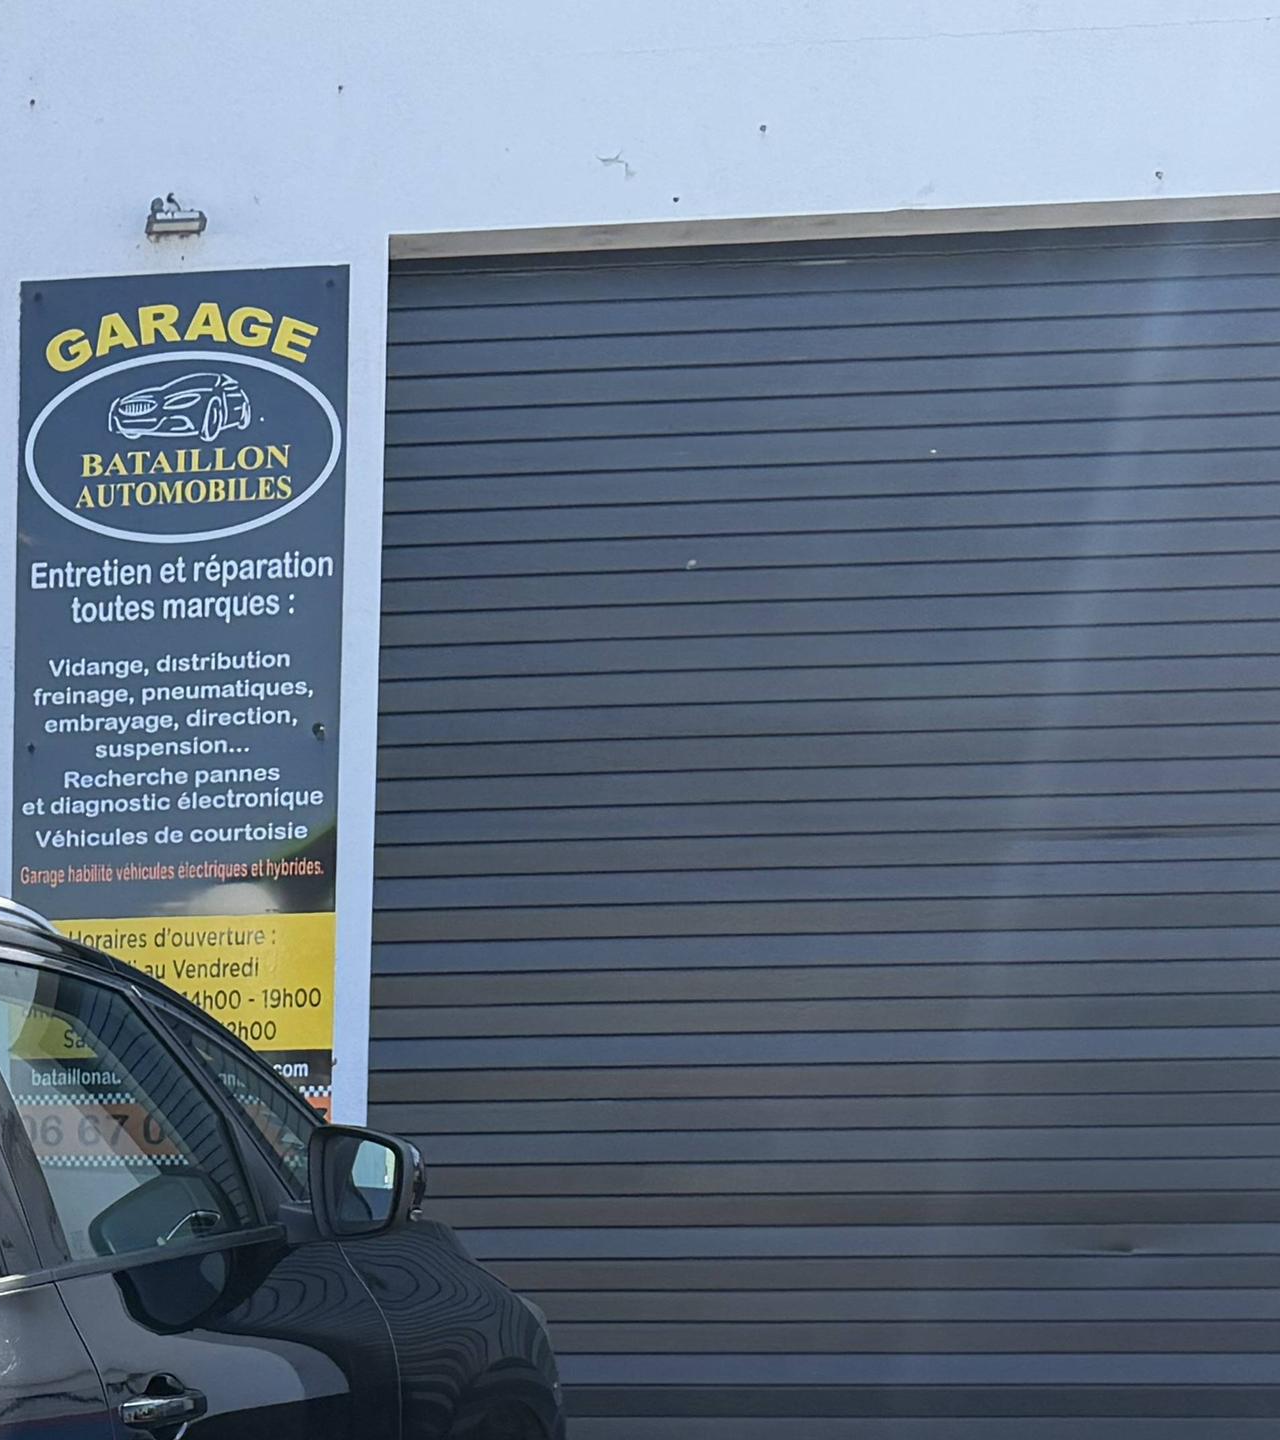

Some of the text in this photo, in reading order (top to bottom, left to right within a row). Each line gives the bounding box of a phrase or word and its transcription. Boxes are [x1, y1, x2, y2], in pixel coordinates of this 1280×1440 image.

[45, 302, 319, 373] GARAGE
[80, 444, 291, 478] BATAILLON
[75, 475, 292, 509] AUTOMOBILES
[31, 550, 334, 589] Entretien et réparation
[72, 596, 155, 624] toutes
[162, 594, 280, 623] marques
[48, 651, 291, 679] Vidange, distribution
[33, 680, 314, 708] freinage, pneumatiques,
[44, 707, 298, 735] embrayage, direction,
[95, 737, 250, 760] suspension...
[63, 767, 281, 789] Recherche pannes
[22, 787, 324, 818] et diagnostic électronique
[35, 822, 308, 849] Véhicules de courtoisie
[20, 858, 325, 888] Garage habilité véhicules électriques et hybrides.
[154, 927, 265, 947] d'ouverture
[173, 957, 259, 979] Vendredi
[262, 988, 322, 1009] 19h00
